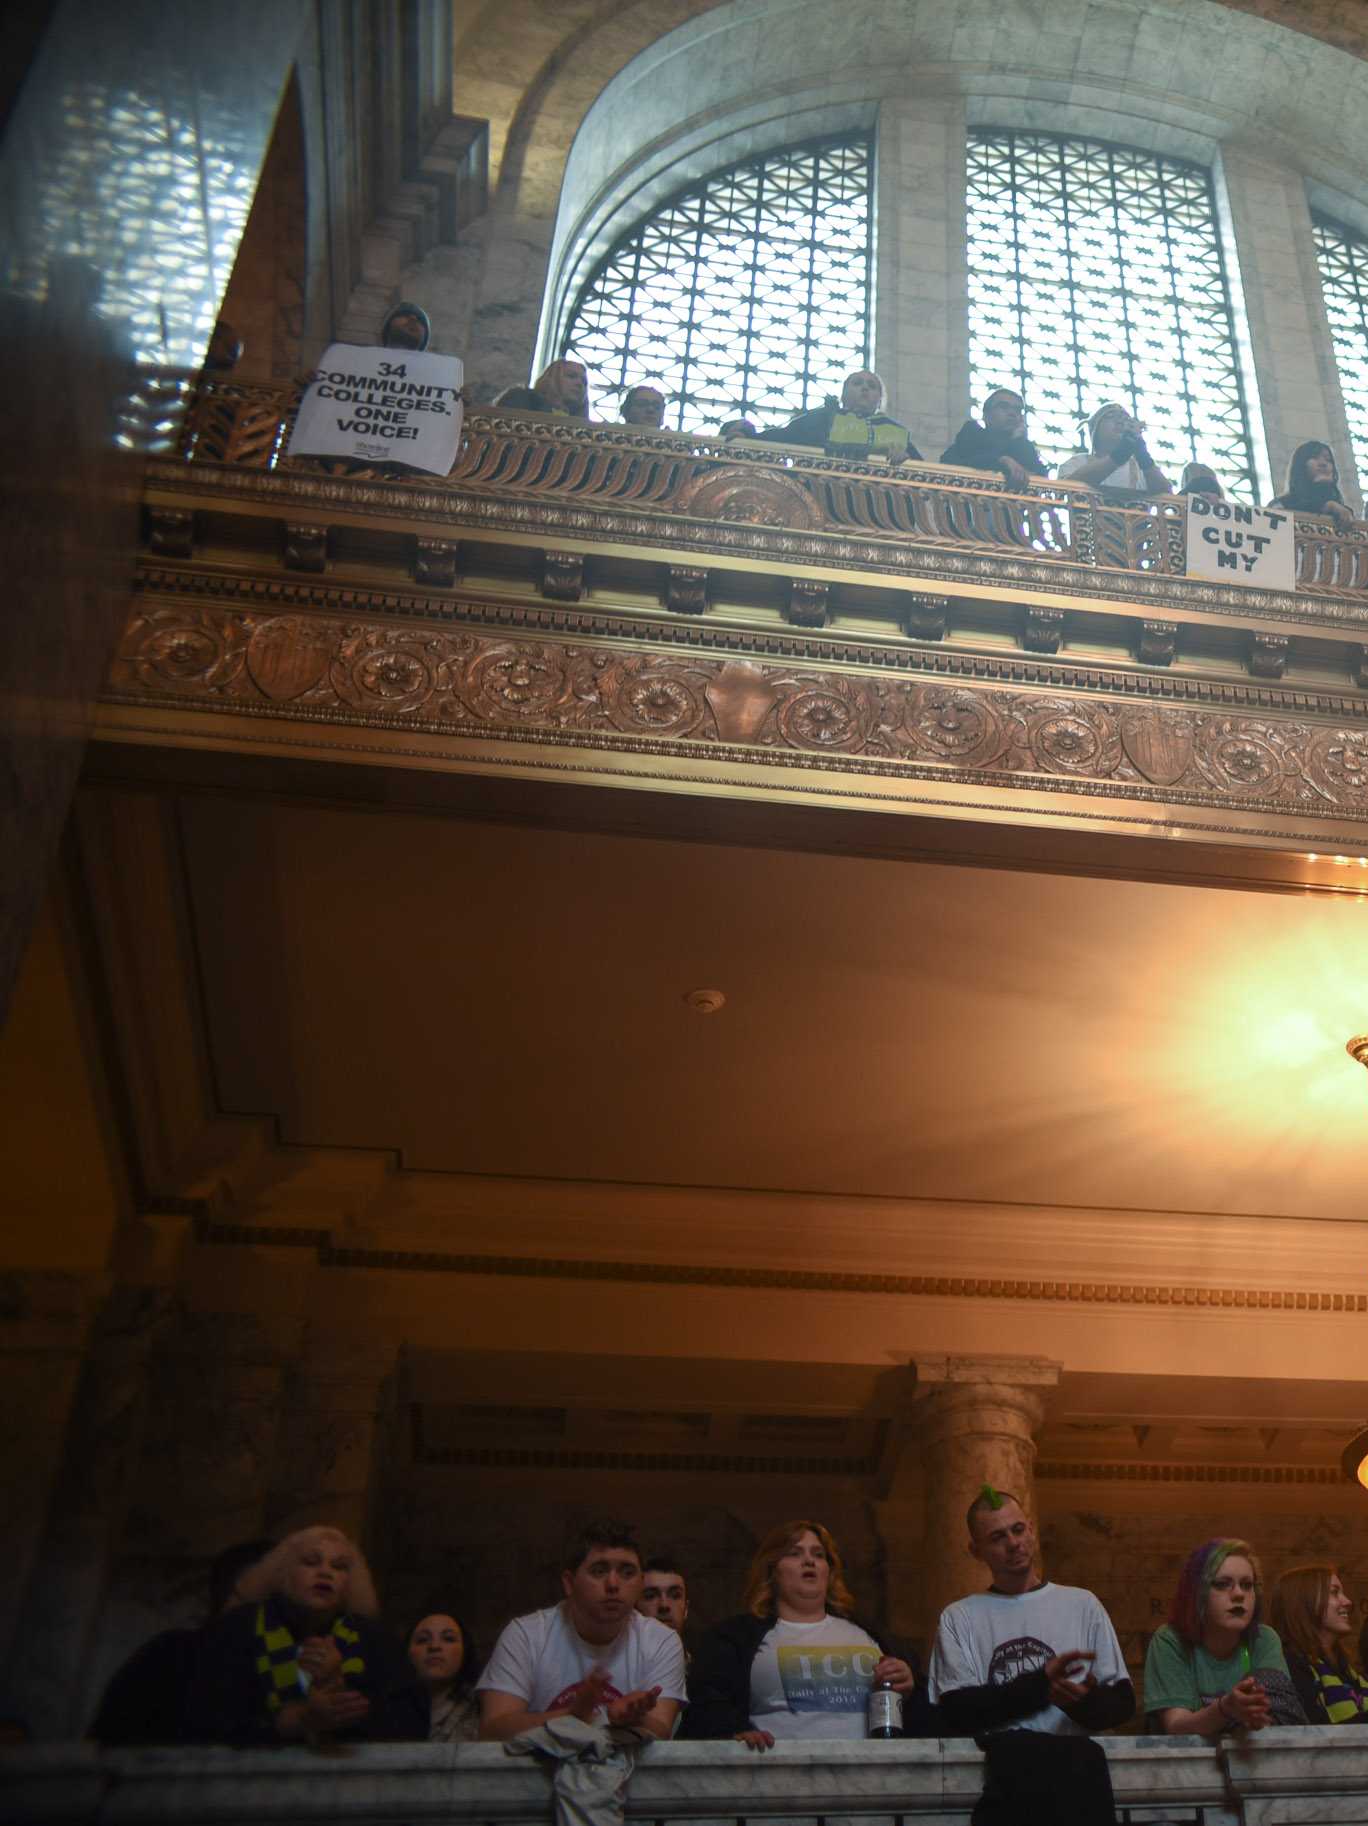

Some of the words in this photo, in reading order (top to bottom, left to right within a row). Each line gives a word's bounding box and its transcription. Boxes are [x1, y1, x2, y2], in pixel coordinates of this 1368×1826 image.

[376, 362, 408, 379] 34
[315, 369, 463, 402] COMMUNITY
[317, 385, 452, 416] COLLEGES.
[354, 406, 409, 424] ONE
[336, 419, 420, 440] VOICE!
[1190, 497, 1287, 530] DON'T
[1202, 527, 1271, 554] CUT
[1217, 550, 1258, 572] MY
